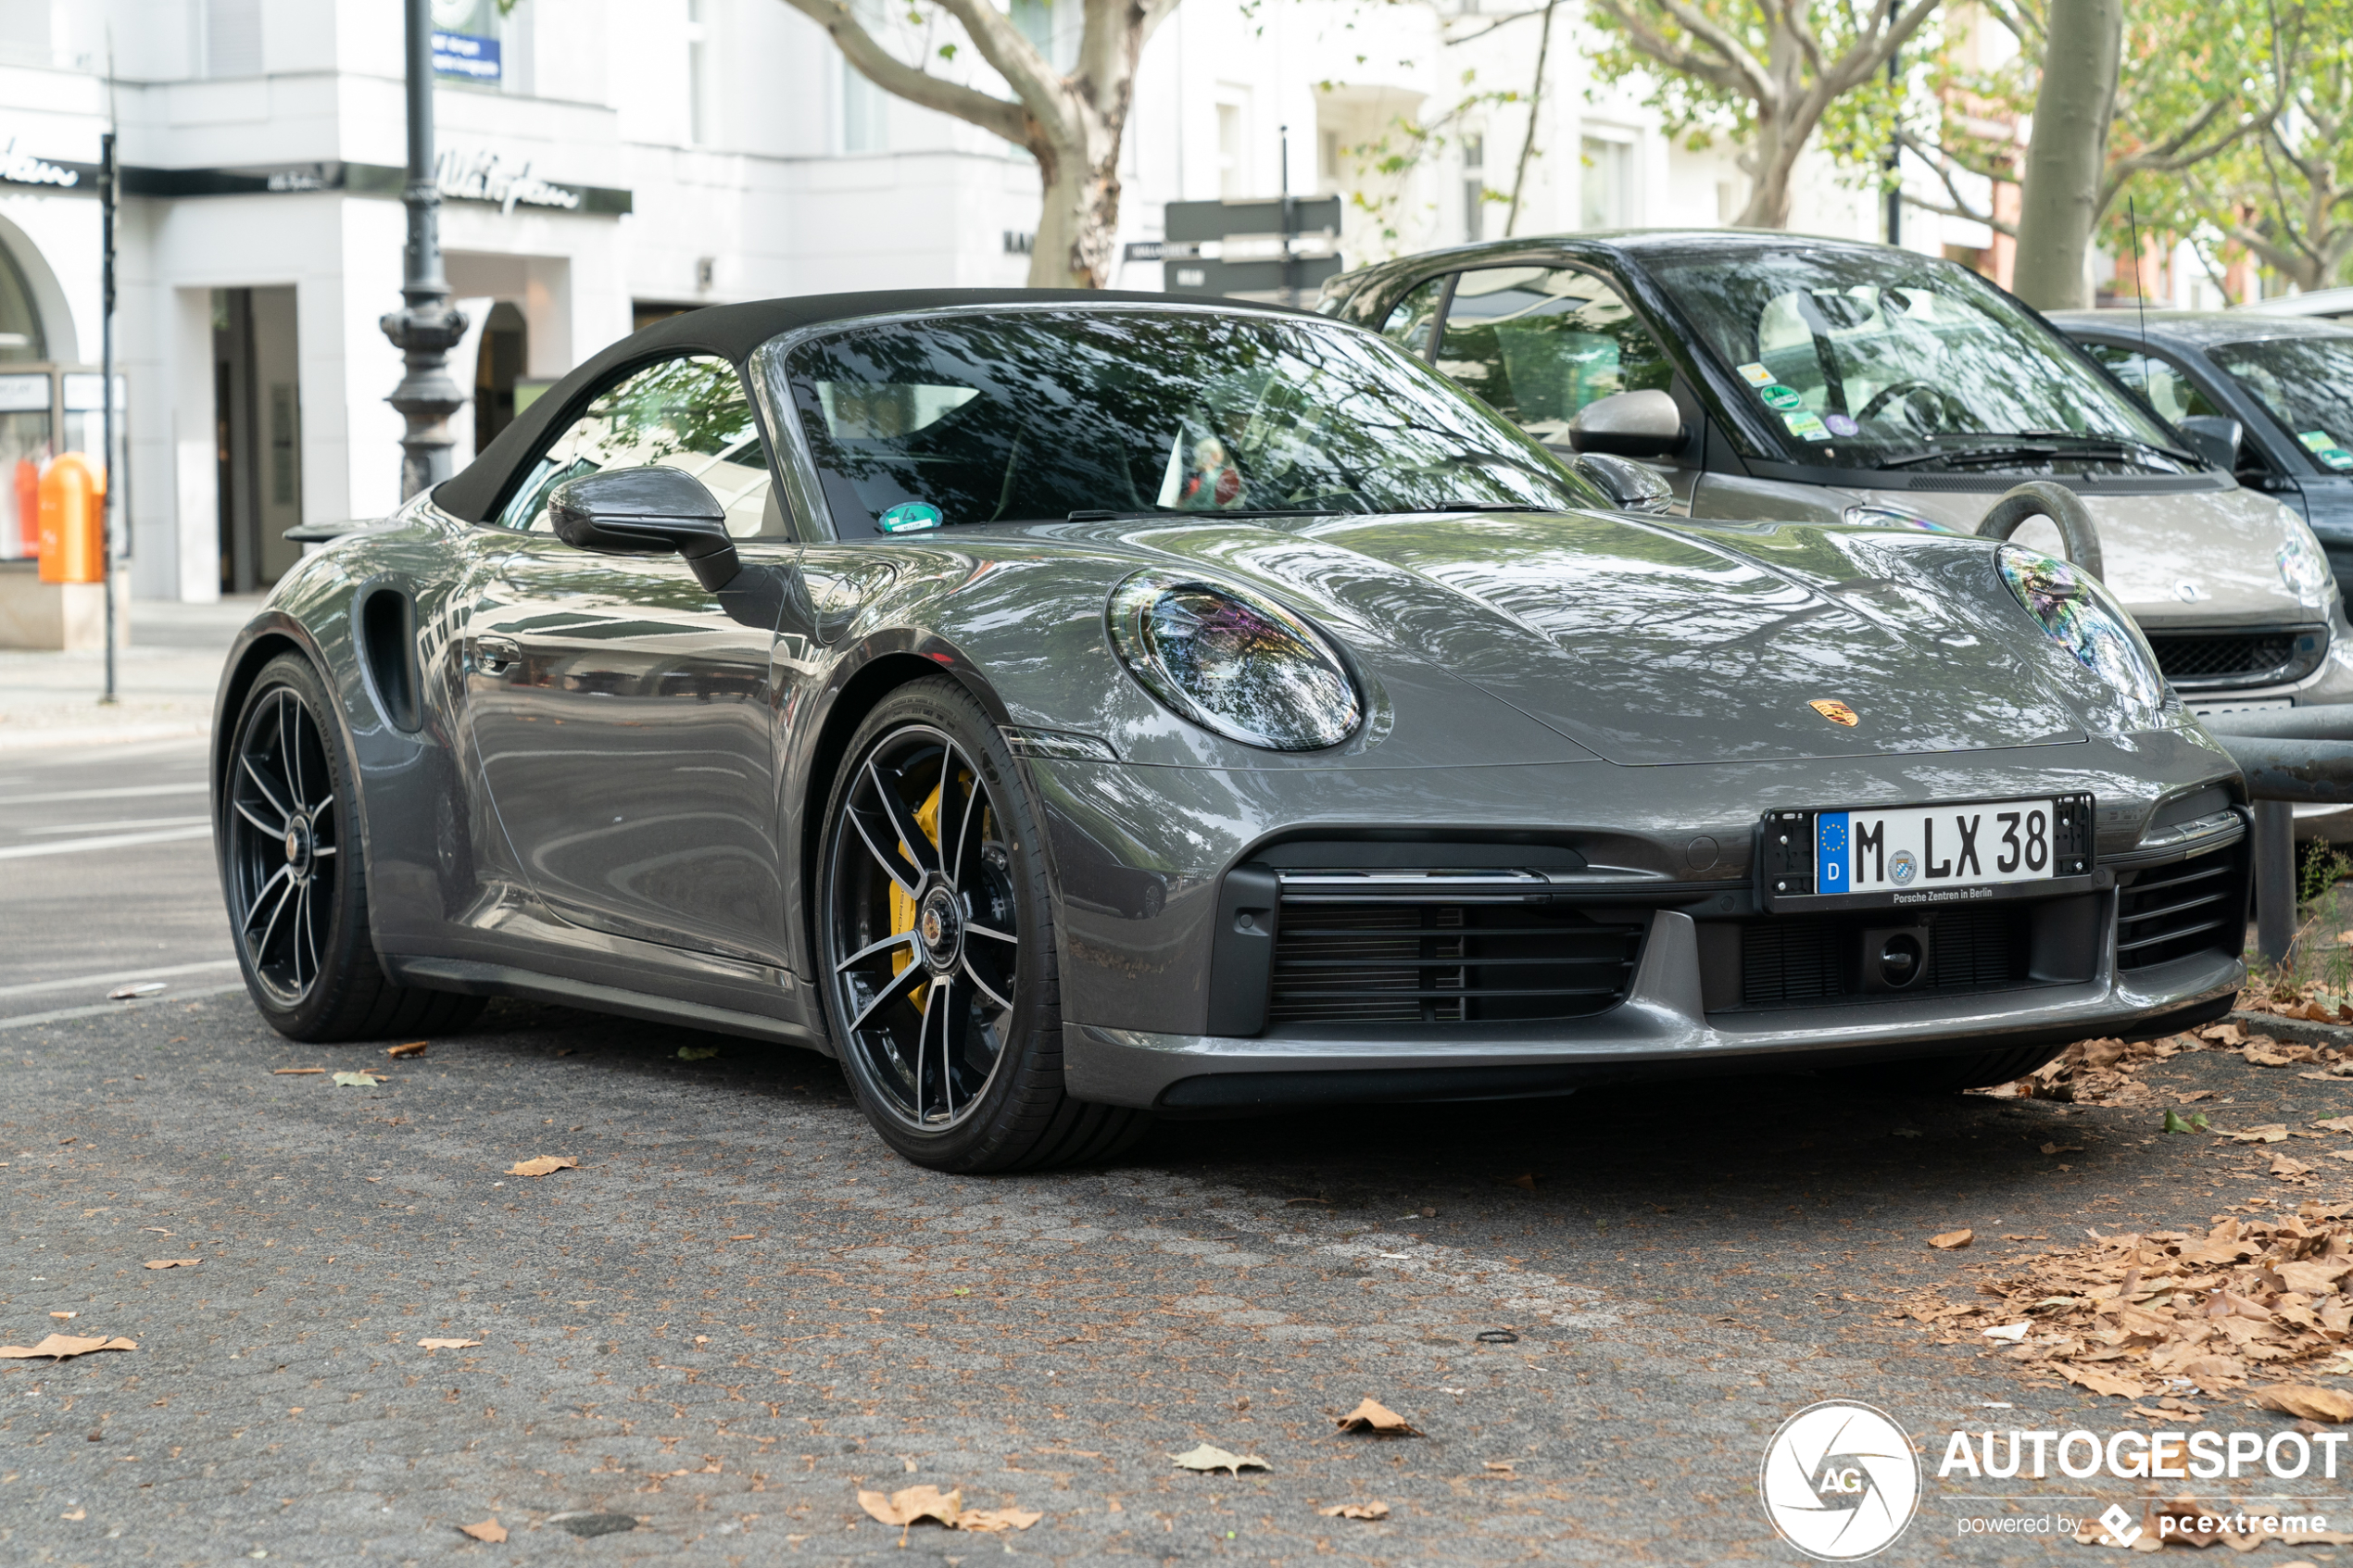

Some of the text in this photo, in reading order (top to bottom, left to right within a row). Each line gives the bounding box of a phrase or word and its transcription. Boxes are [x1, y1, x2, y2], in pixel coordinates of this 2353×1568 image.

[902, 508, 916, 521] 4
[313, 701, 339, 788] GOODYEAR
[1856, 821, 1884, 883] M
[1925, 814, 1981, 878] LX
[1996, 809, 2048, 873] 38
[1827, 862, 1840, 881] D
[1894, 887, 1993, 904] Porsche Zentren in Berlin
